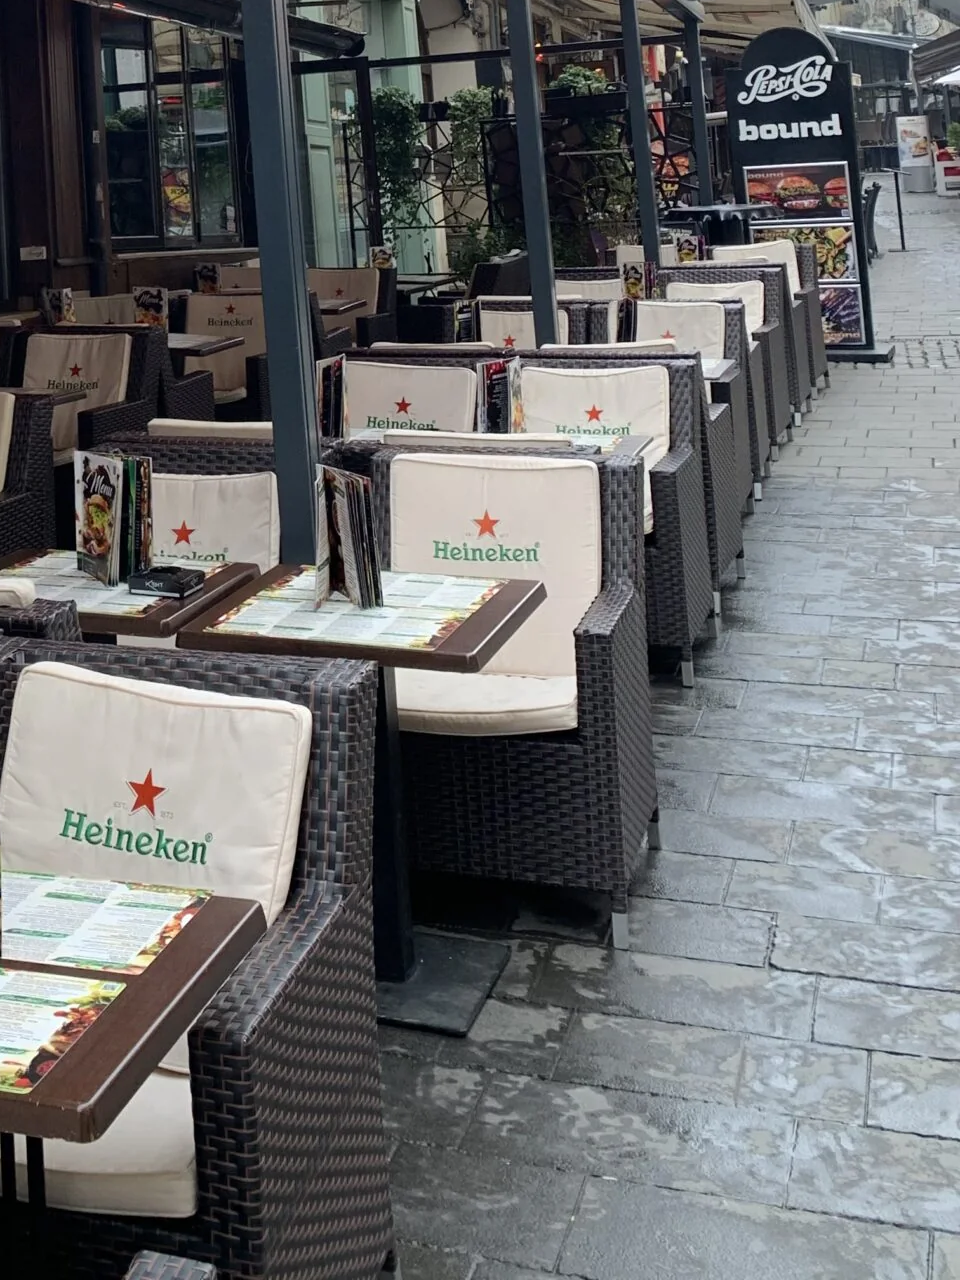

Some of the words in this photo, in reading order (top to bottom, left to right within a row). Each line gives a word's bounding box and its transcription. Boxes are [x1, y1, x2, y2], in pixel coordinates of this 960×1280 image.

[738, 113, 842, 141] bound
[207, 317, 253, 327] Heineken
[47, 379, 99, 392] Heineken
[366, 415, 435, 430] Heineken
[86, 472, 114, 498] Menu
[432, 539, 540, 562] Heineken
[59, 808, 208, 866] Heineken
